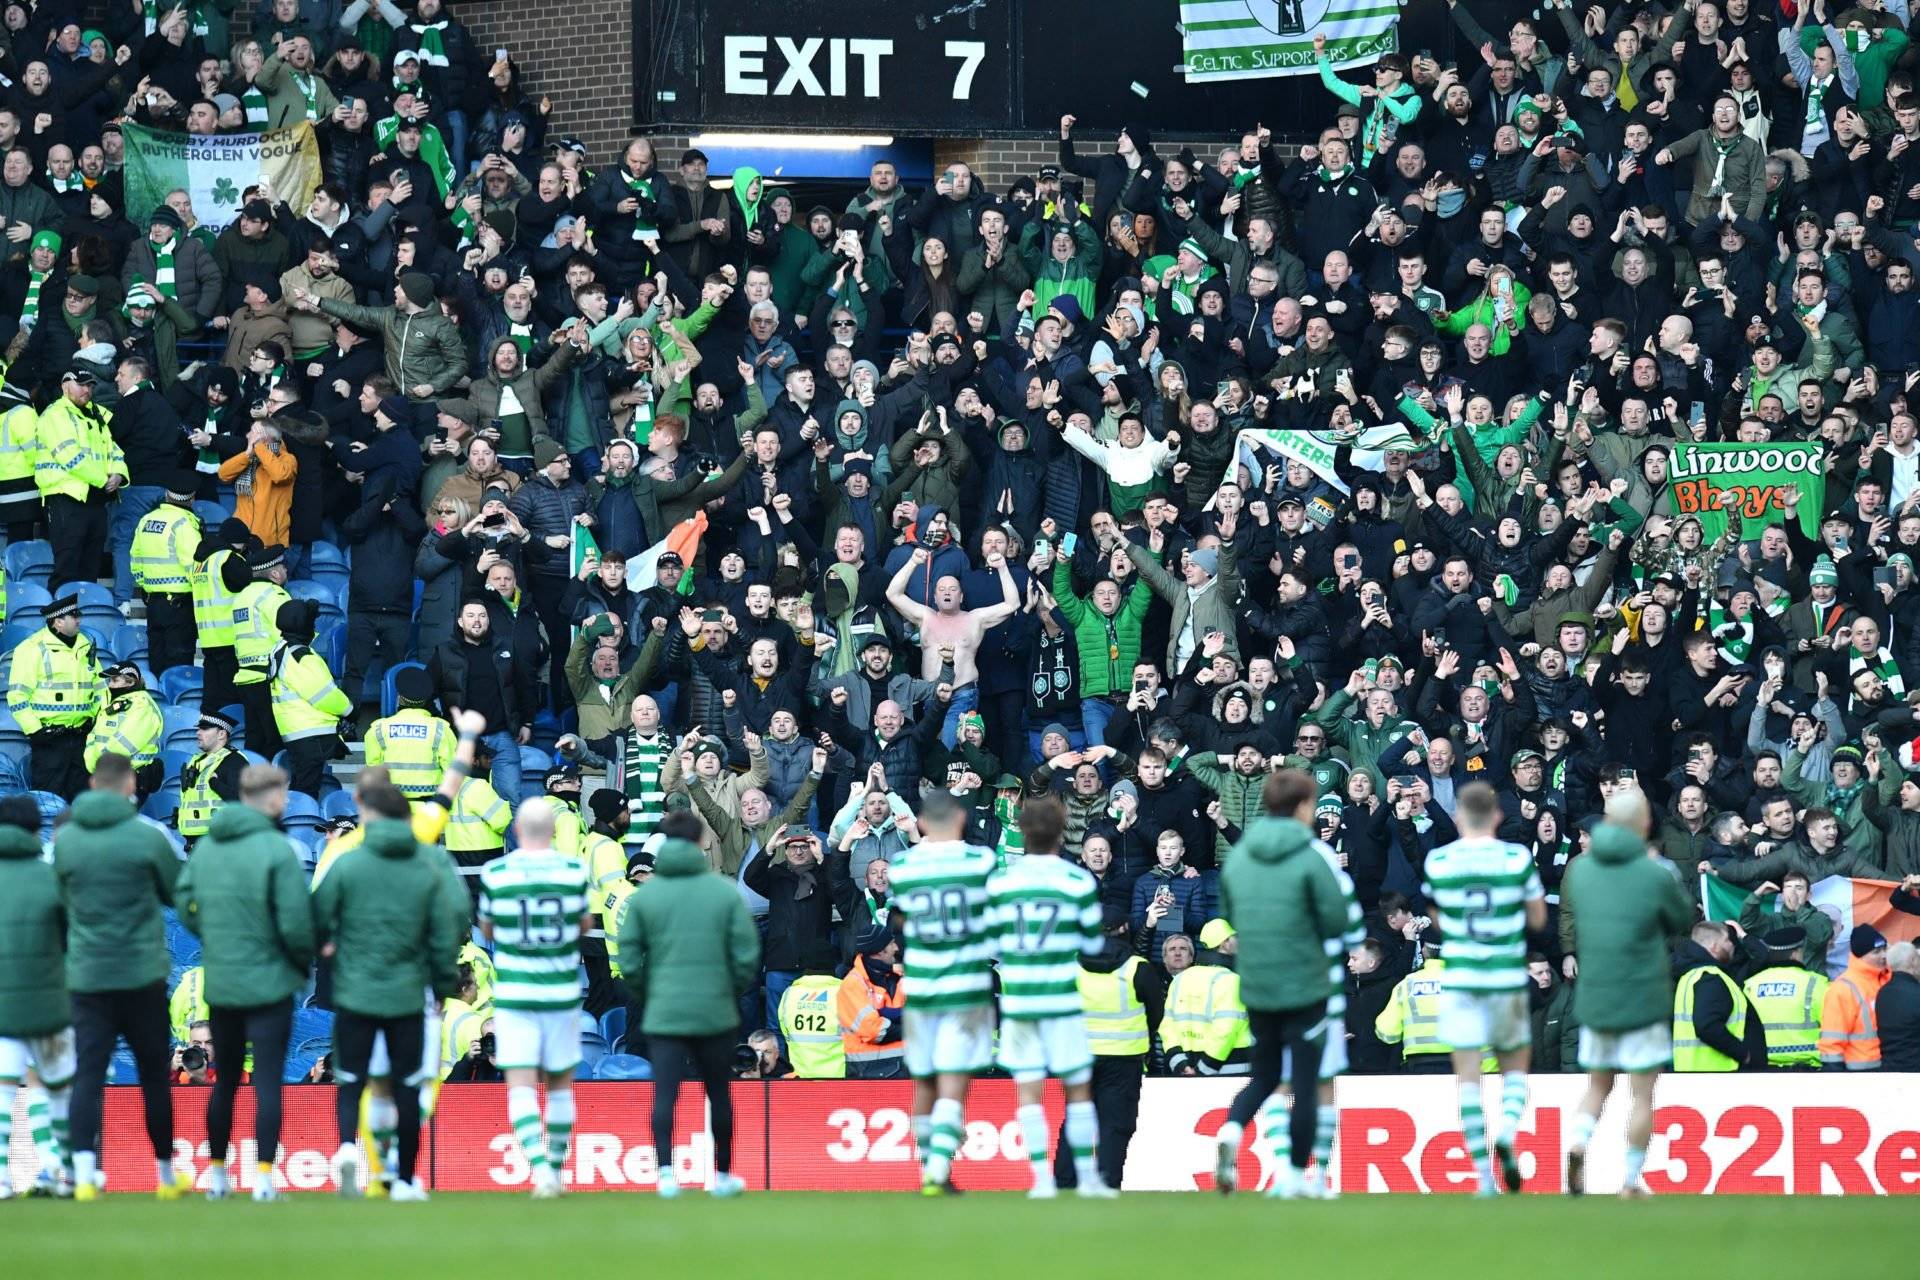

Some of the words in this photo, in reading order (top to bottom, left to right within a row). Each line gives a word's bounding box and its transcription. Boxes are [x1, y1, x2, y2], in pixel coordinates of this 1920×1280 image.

[724, 35, 893, 97] EXIT
[944, 41, 986, 99] 7
[1190, 54, 1243, 72] CELTIC
[141, 142, 244, 161] RUTHERGLEN
[249, 141, 301, 160] VOGUE
[212, 130, 293, 147] MURDOCH
[1669, 444, 1824, 480] Linwood
[143, 521, 166, 534] POLICE
[391, 725, 426, 737] POLICE
[518, 894, 565, 948] 13
[908, 885, 971, 942] 20
[1464, 884, 1497, 939] 2
[1014, 900, 1063, 952] 17
[1759, 983, 1794, 996] POLICE
[795, 1014, 826, 1032] 612
[1192, 1107, 1561, 1192] 3Red
